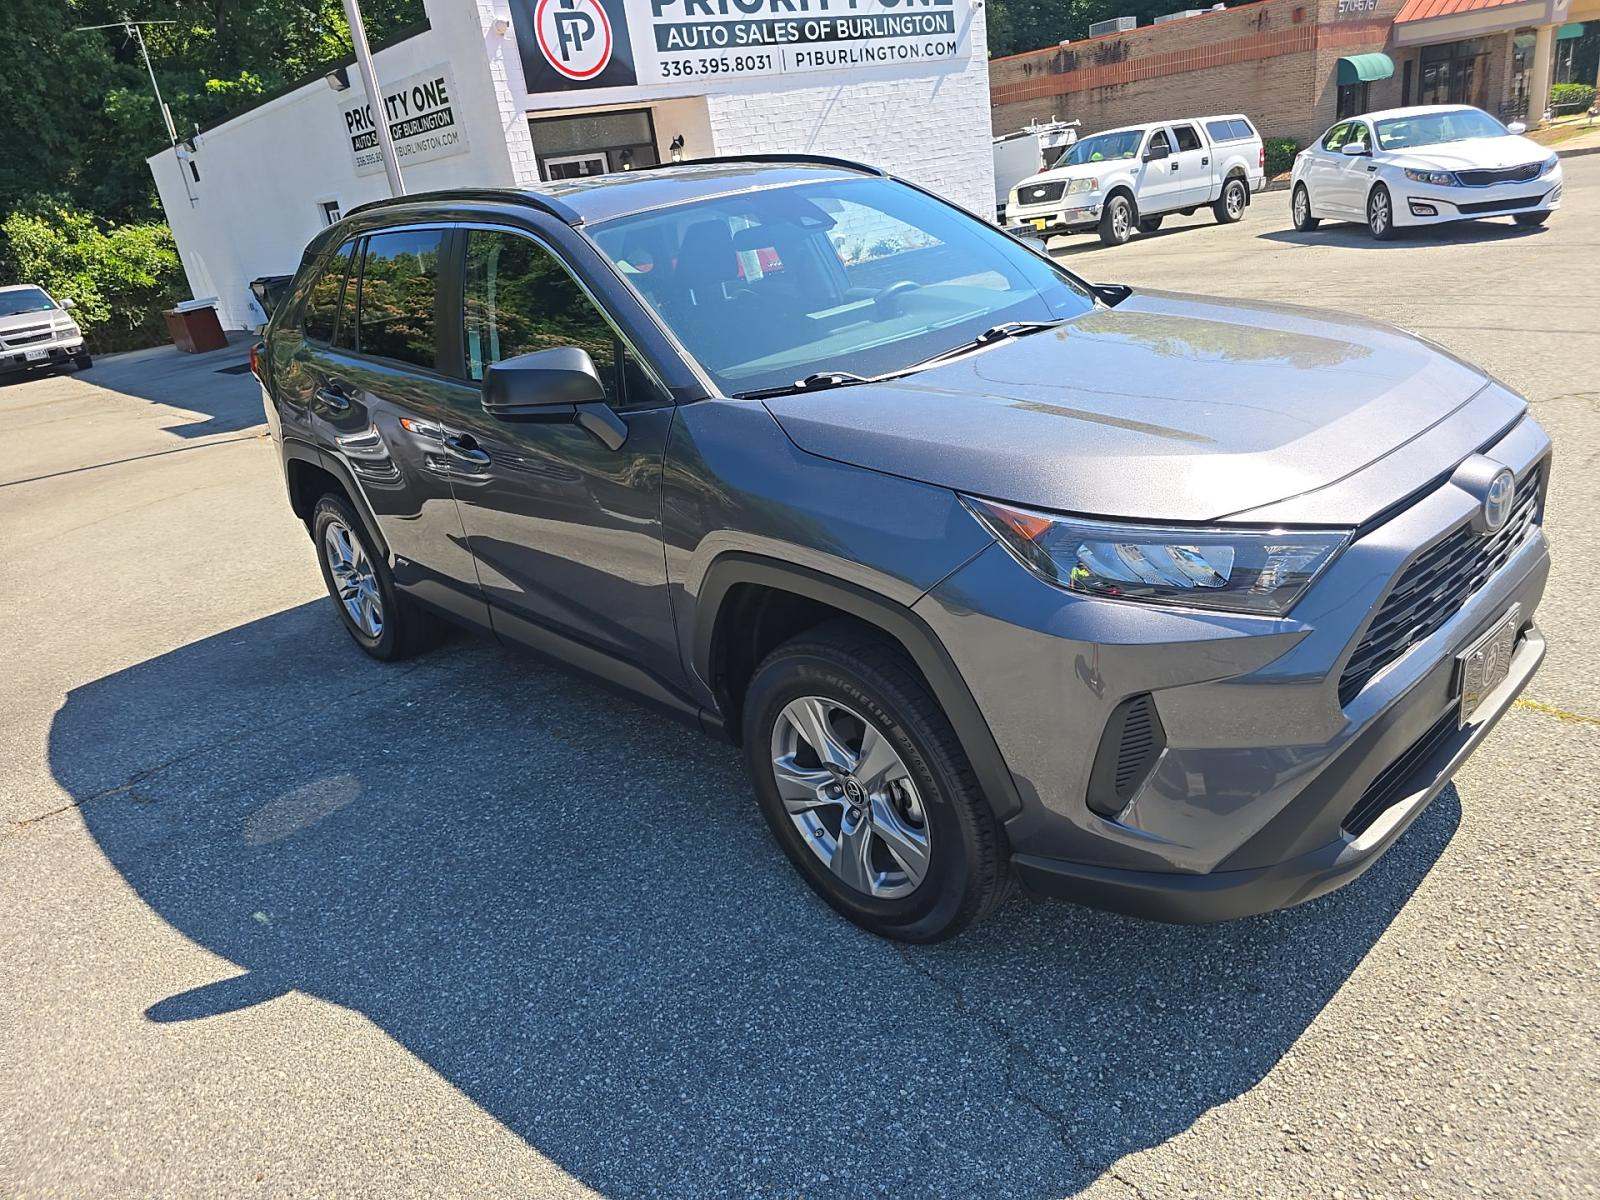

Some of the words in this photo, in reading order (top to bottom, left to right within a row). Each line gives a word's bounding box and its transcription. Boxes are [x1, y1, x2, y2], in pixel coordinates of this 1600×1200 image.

[667, 25, 728, 48] AUTO
[735, 22, 799, 44] SALES
[804, 21, 831, 40] OF
[837, 14, 948, 39] BURLINGTON
[660, 54, 772, 77] 336.395.8031
[796, 42, 957, 67] P1BURLINGTON.COM
[345, 91, 409, 134] PRIOITY
[412, 77, 449, 112] ONE
[354, 134, 372, 149] AUTO
[392, 124, 403, 139] OF
[403, 110, 451, 136] BURLINGTON
[826, 675, 894, 726] MICHELIN
